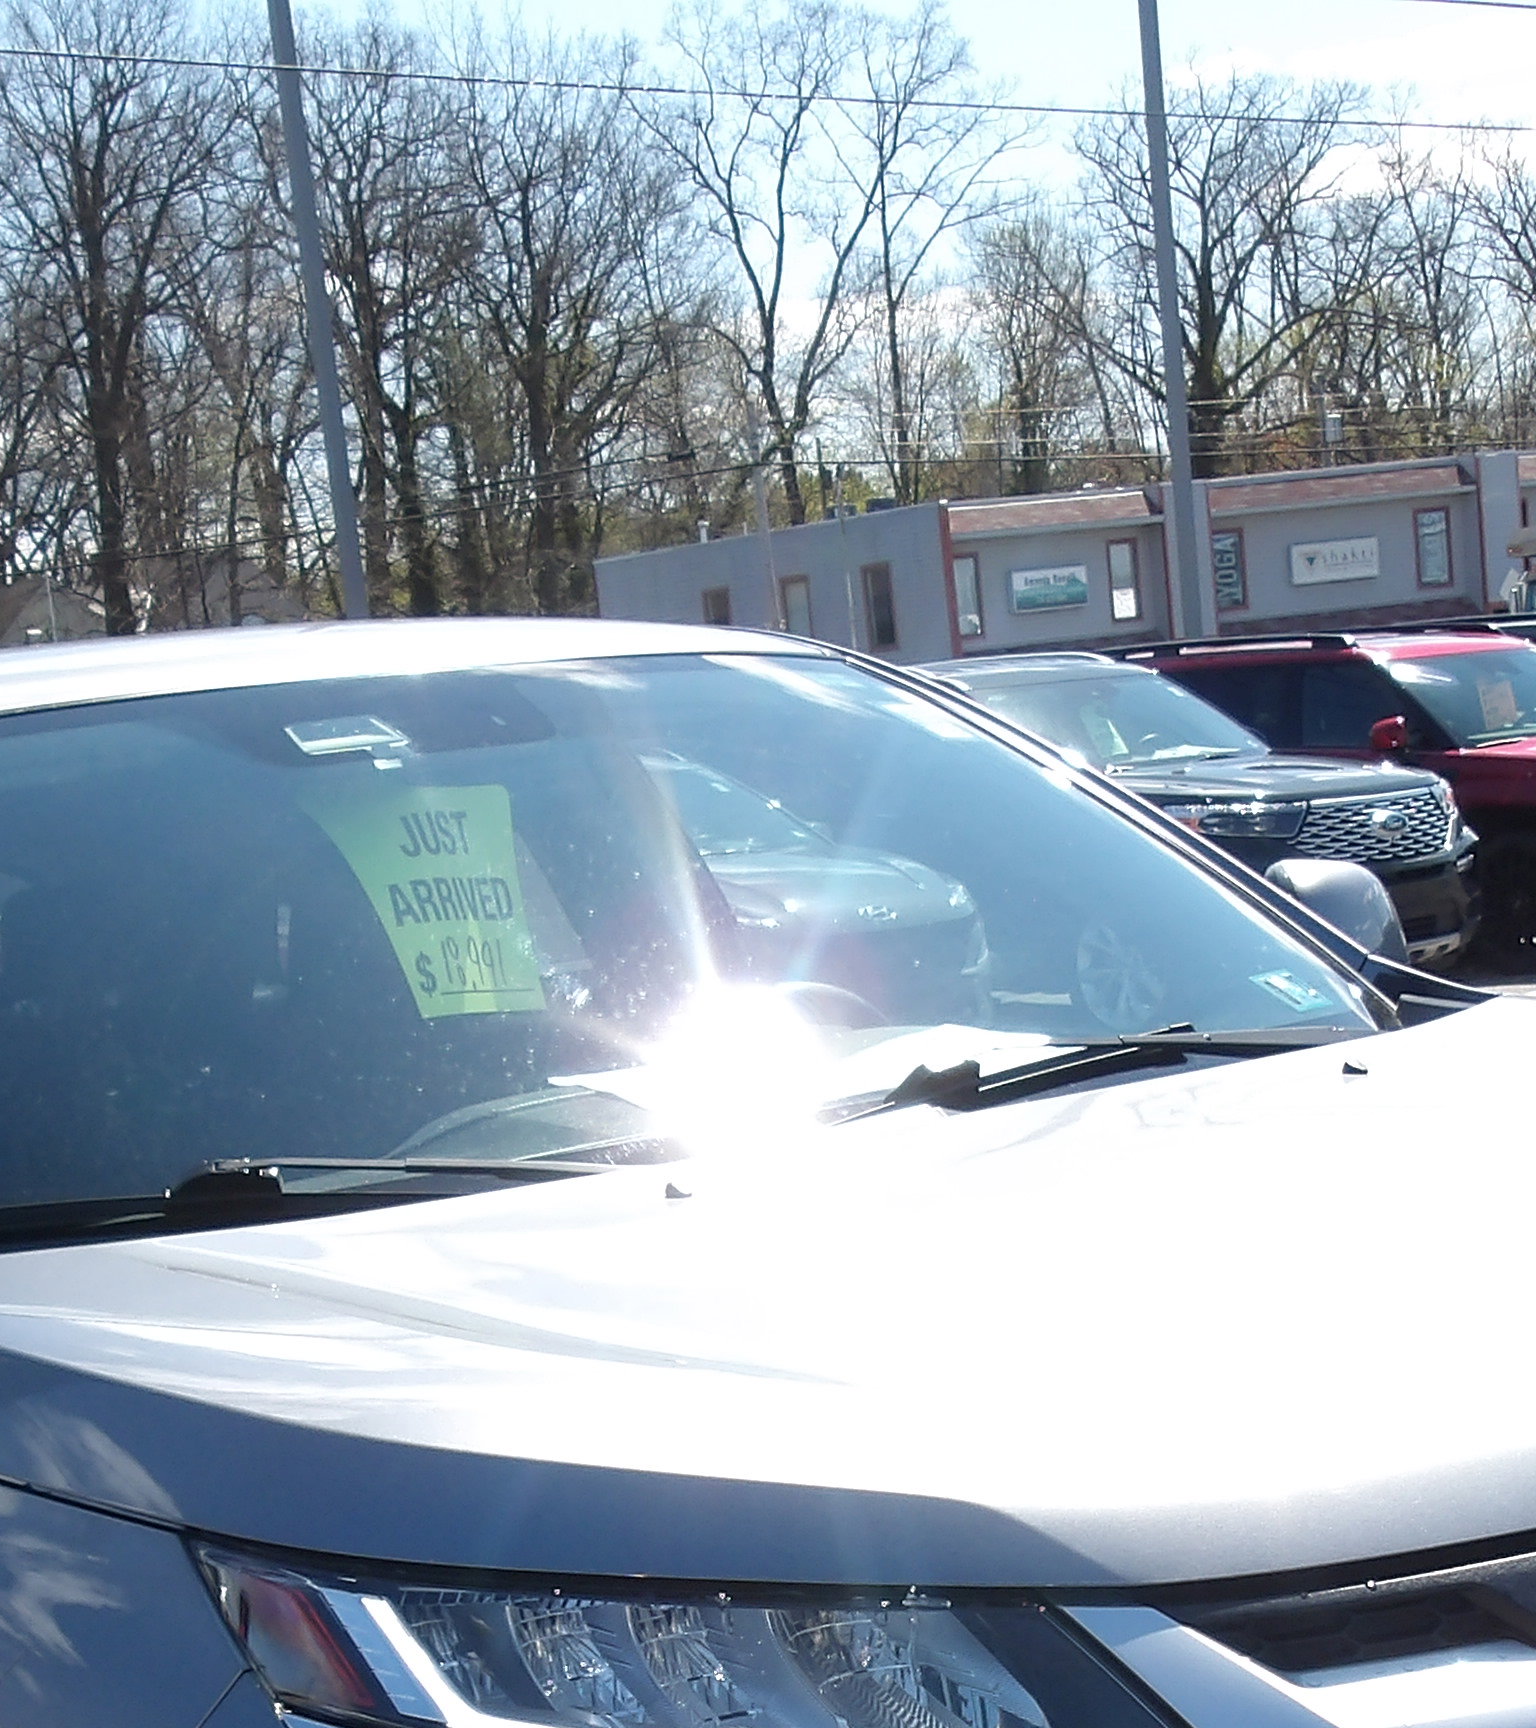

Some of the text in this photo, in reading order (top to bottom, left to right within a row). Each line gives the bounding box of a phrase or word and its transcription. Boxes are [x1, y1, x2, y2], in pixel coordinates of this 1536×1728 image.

[1212, 535, 1243, 605] YOGA
[400, 810, 469, 857] JUST
[387, 876, 514, 928] ARRIVED
